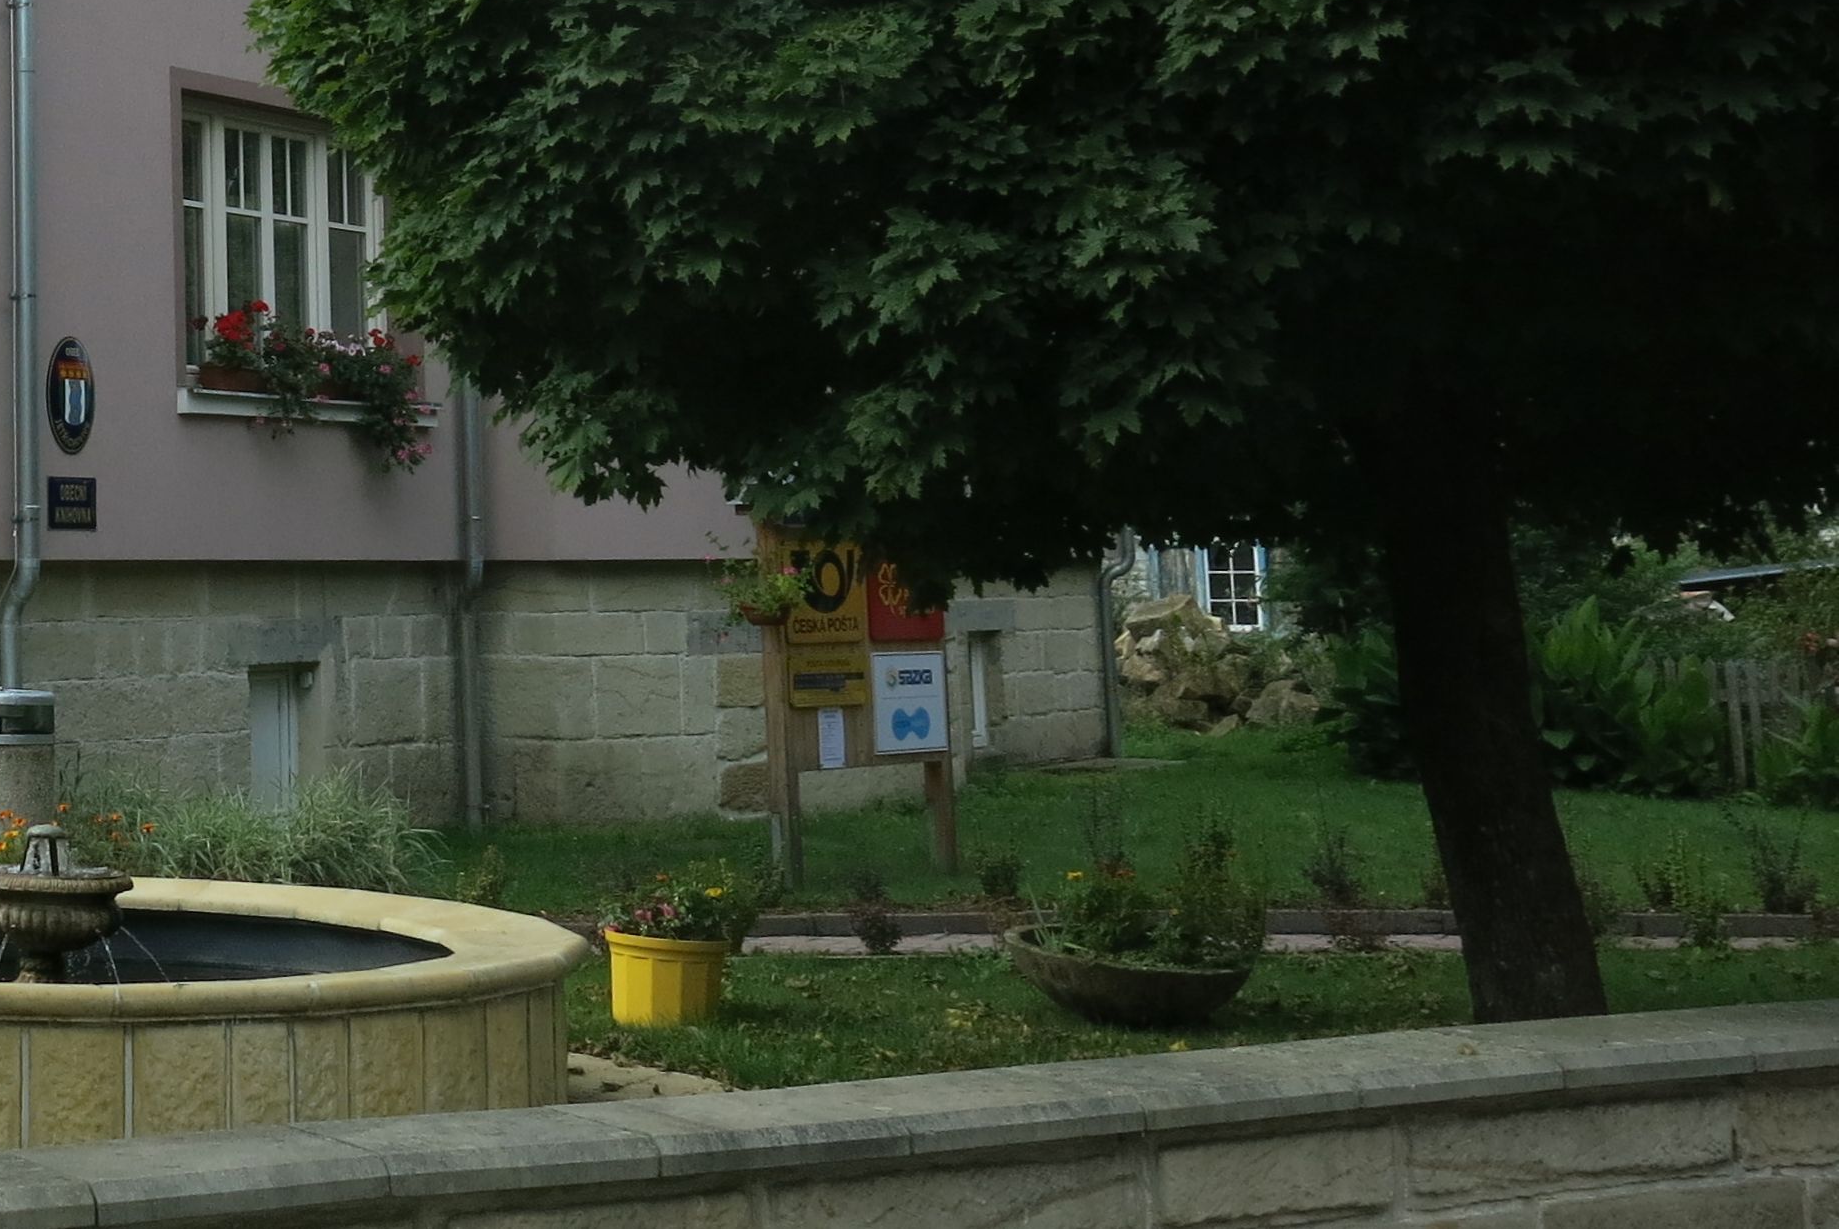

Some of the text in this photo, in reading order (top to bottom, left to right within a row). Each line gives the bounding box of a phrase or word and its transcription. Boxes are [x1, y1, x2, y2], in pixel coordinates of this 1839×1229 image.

[60, 480, 87, 501] OBECNÍ
[792, 614, 859, 634] ČESKÁ POŠTA
